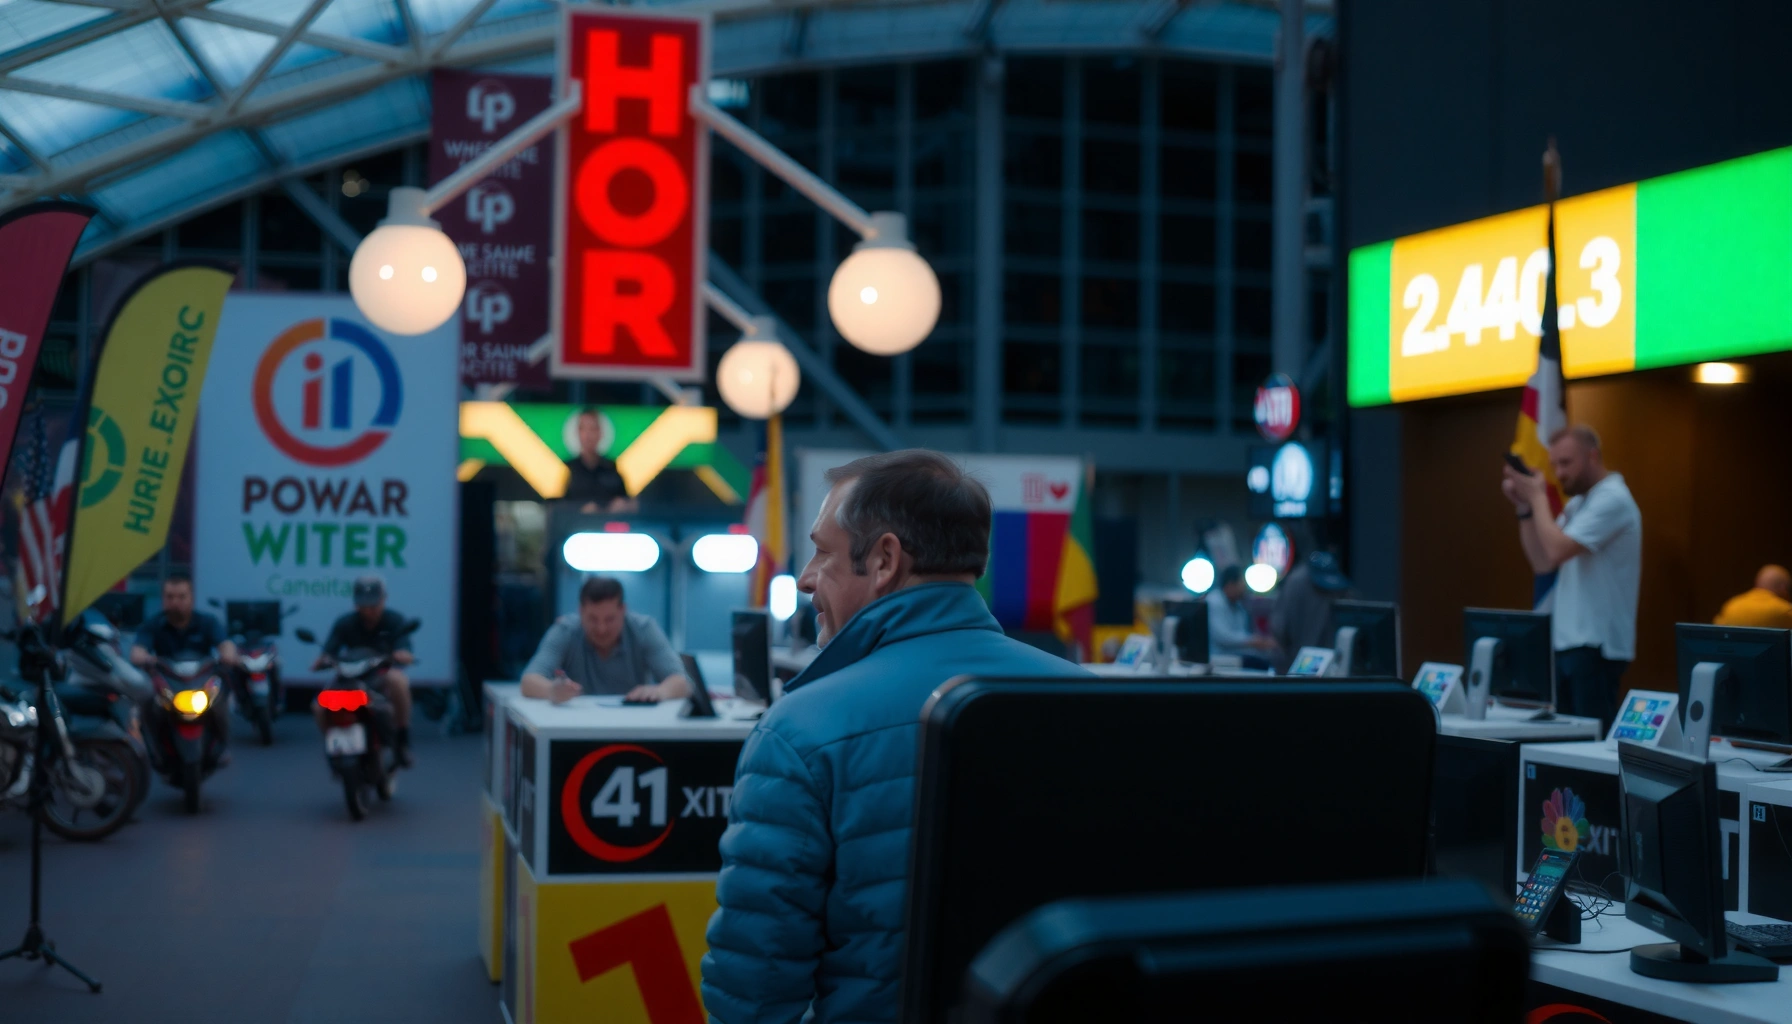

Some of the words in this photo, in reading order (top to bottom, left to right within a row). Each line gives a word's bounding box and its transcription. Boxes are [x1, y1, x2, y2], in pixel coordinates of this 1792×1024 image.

[575, 28, 689, 357] HOR
[243, 475, 409, 518] POWAR
[242, 522, 408, 568] WITER
[591, 766, 668, 827] 41
